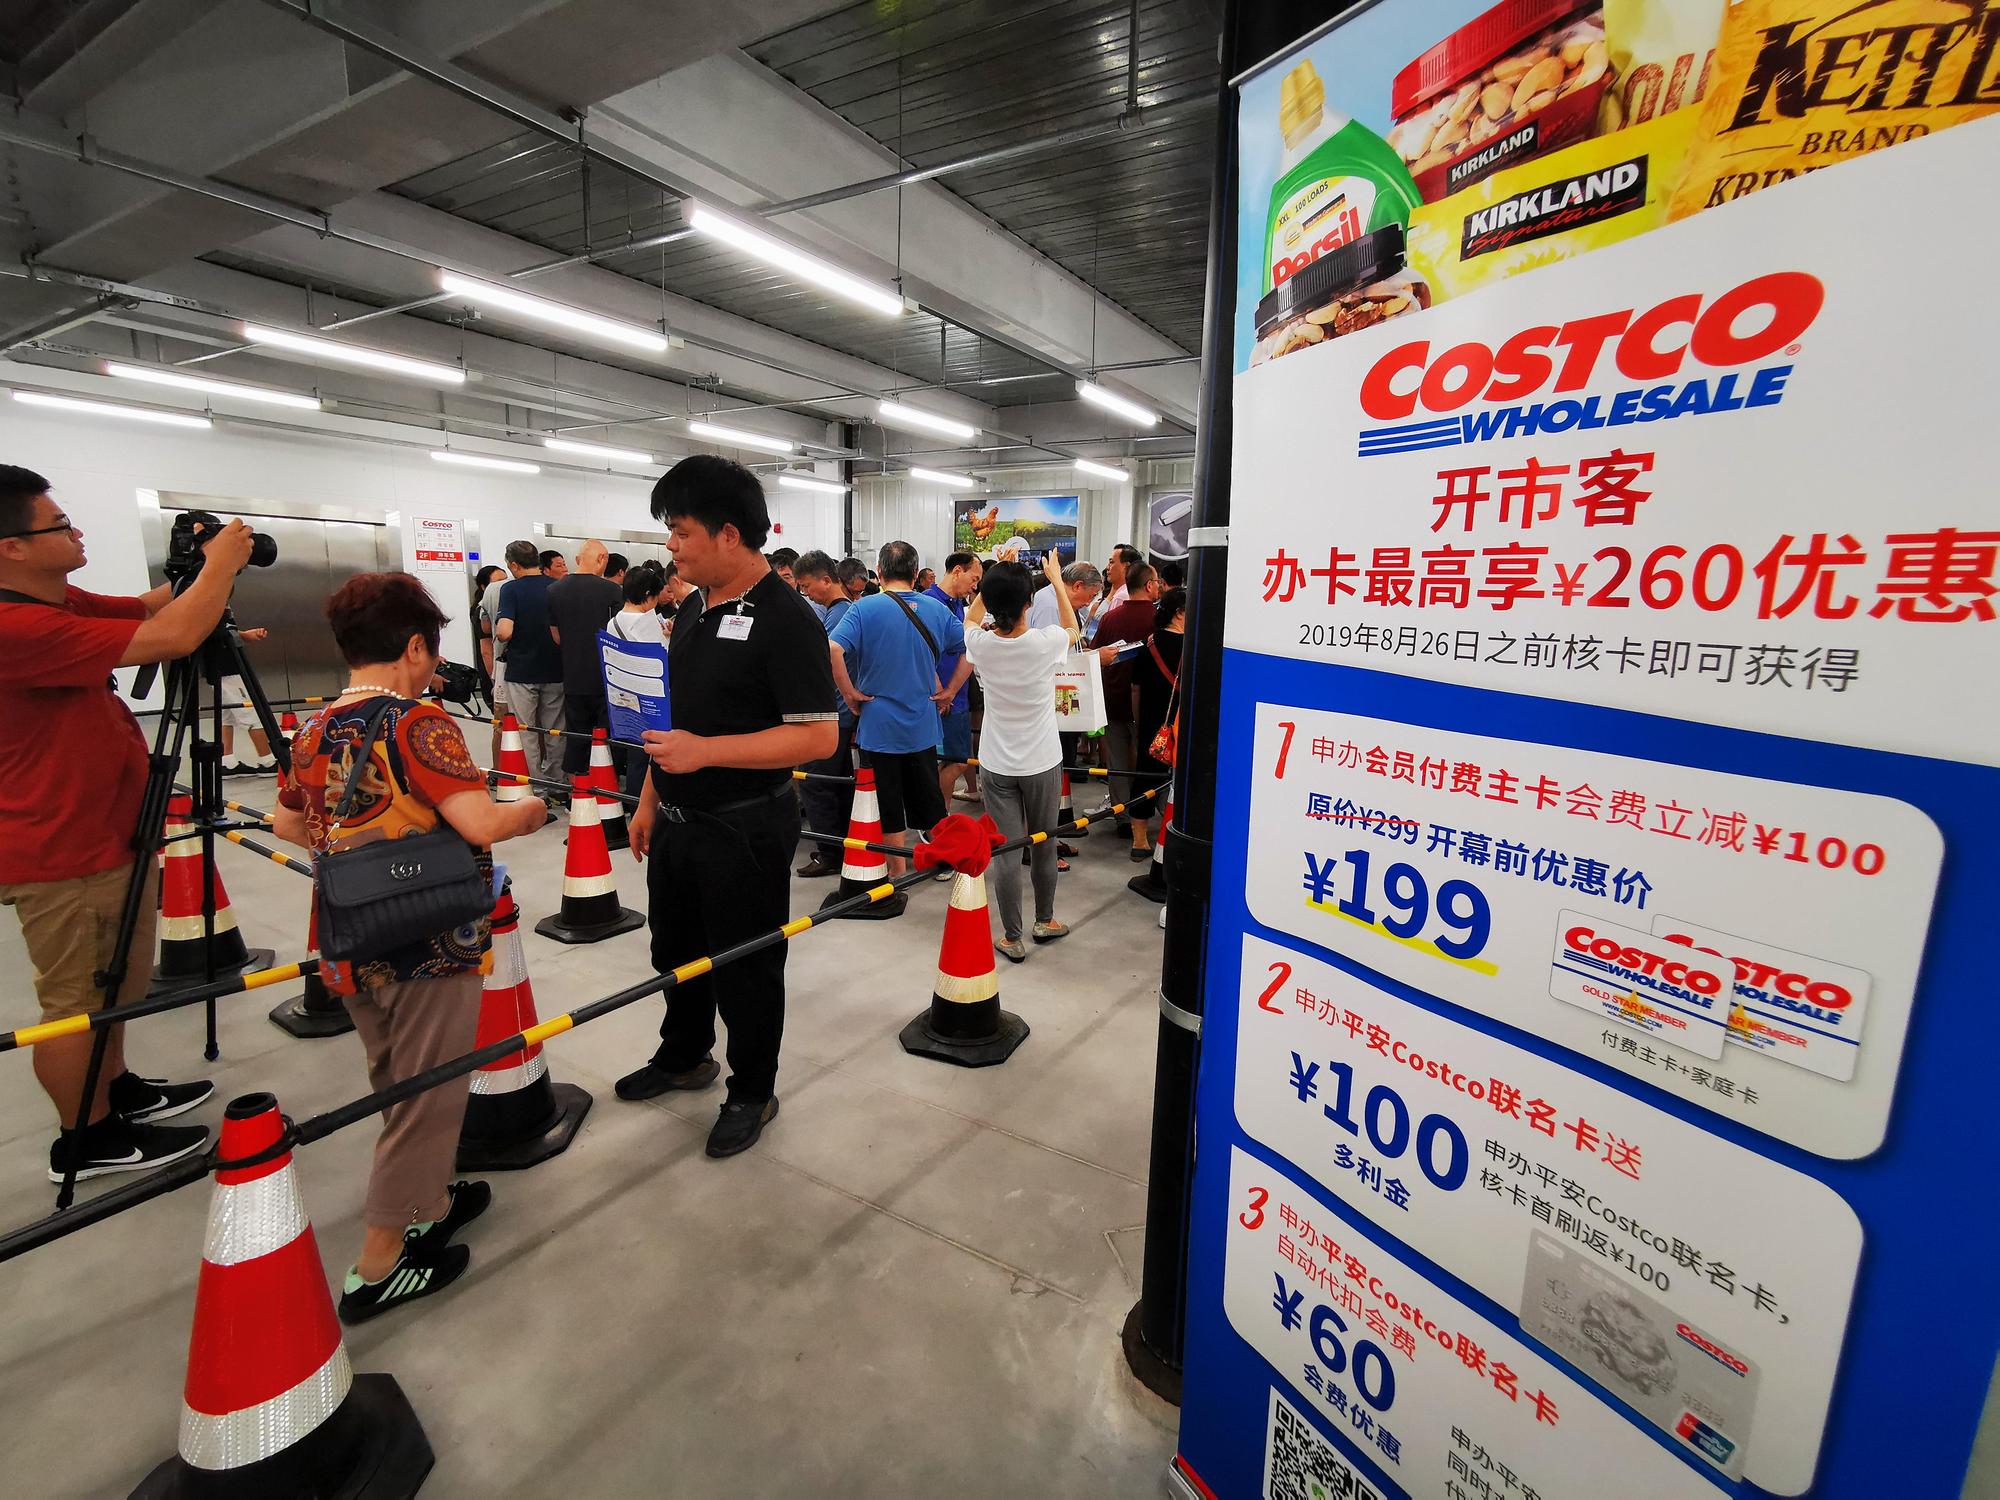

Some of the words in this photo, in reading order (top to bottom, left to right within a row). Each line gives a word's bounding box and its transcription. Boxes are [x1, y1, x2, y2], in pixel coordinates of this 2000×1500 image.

[1451, 126, 1535, 183] KIRKLAND
[1278, 212, 1290, 227] XXL
[1294, 197, 1307, 213] 100
[1307, 181, 1329, 204] LOADS
[1467, 197, 1638, 257] Signature
[1469, 162, 1640, 238] KIRKLAND
[1359, 271, 1825, 420] COSTCO
[1461, 364, 1795, 444] WHOLESALE
[422, 520, 453, 528] COSTCO
[1430, 447, 1656, 533] 开市客
[1262, 528, 2000, 623] 办卡最高享¥260优惠
[1298, 622, 1860, 693] 2019年8月26日之前核卡即可获得
[1274, 721, 1296, 780] 1
[1311, 735, 1886, 876] 申办会员付费主卡会费立减¥100
[1306, 792, 1419, 845] 原价¥299
[1426, 823, 1654, 910] 开幕前优惠价
[1303, 849, 1491, 960] ¥199
[1256, 961, 1293, 1016] 2
[1564, 926, 1722, 995] COSTCO
[1607, 962, 1715, 1010] WHOLESALE
[1662, 933, 1853, 1009] STCO
[1582, 984, 1610, 1002] GOLD
[1611, 994, 1639, 1012] STAR
[1640, 1003, 1688, 1031] MEMBER
[1727, 1012, 1746, 1028] AR
[1747, 1018, 1809, 1049] MEMBER
[1733, 982, 1843, 1026] HOLESALE
[1294, 987, 1644, 1182] 申办平安Costco联名卡送
[1601, 1028, 1760, 1105] 付费主卡+家庭卡
[1288, 1050, 1470, 1193] ¥100
[1238, 1186, 1270, 1230] 3
[1333, 1143, 1412, 1213] 多利金
[1479, 1167, 1671, 1292] 核卡首刷返¥100
[1277, 1233, 1417, 1363] 自动代扣会费
[1279, 1202, 1561, 1427] 申办平安Costco联名卡
[1272, 1271, 1396, 1412] ¥60
[1675, 1323, 1749, 1373] COSTCO
[1303, 1362, 1402, 1466] 会费优惠
